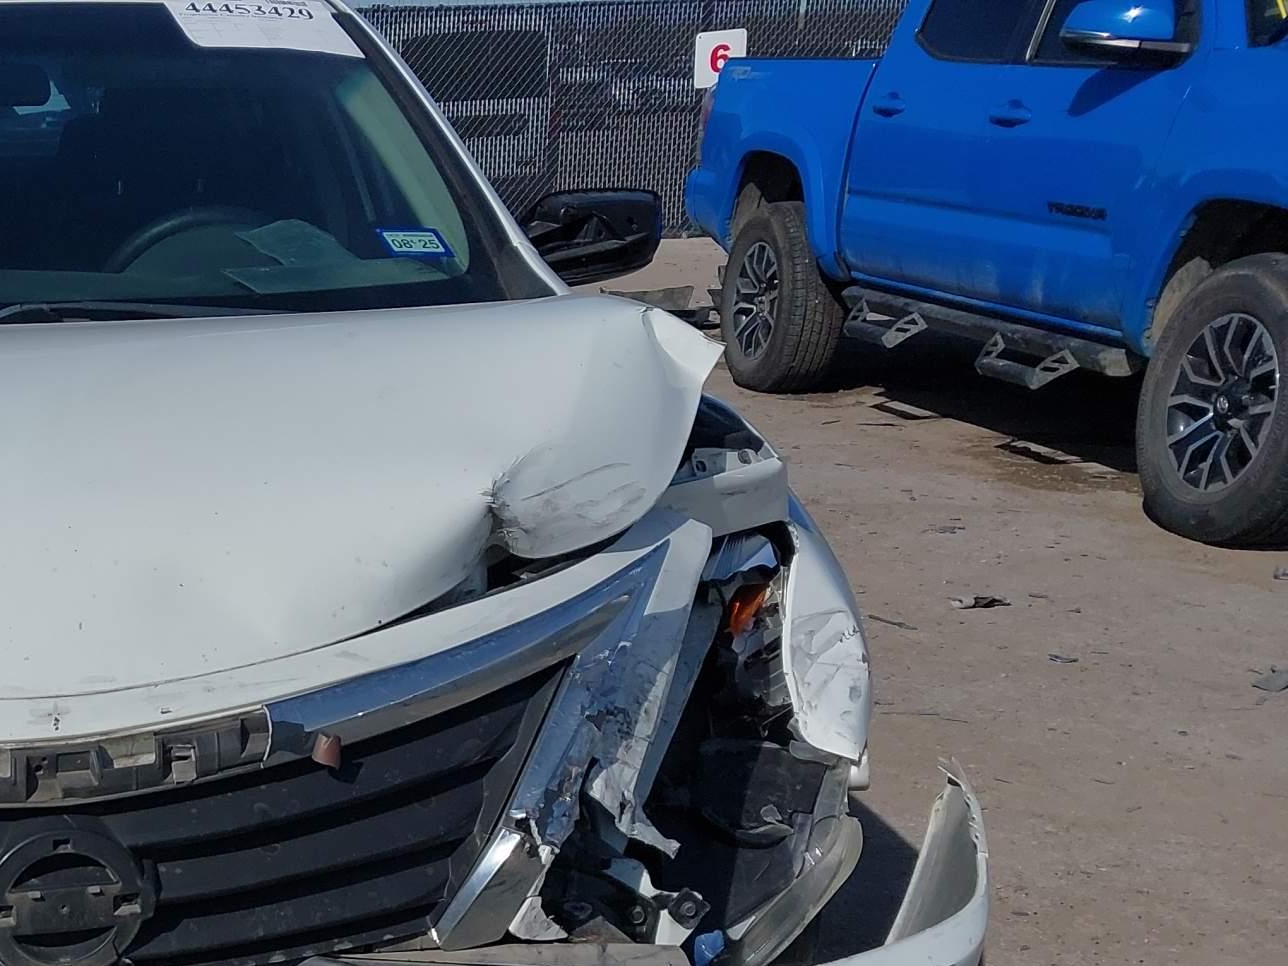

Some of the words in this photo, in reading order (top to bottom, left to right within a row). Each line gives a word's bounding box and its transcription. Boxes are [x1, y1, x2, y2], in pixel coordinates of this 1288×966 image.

[185, 2, 314, 20] 44453429
[710, 44, 731, 73] 6
[418, 239, 440, 249] 25
